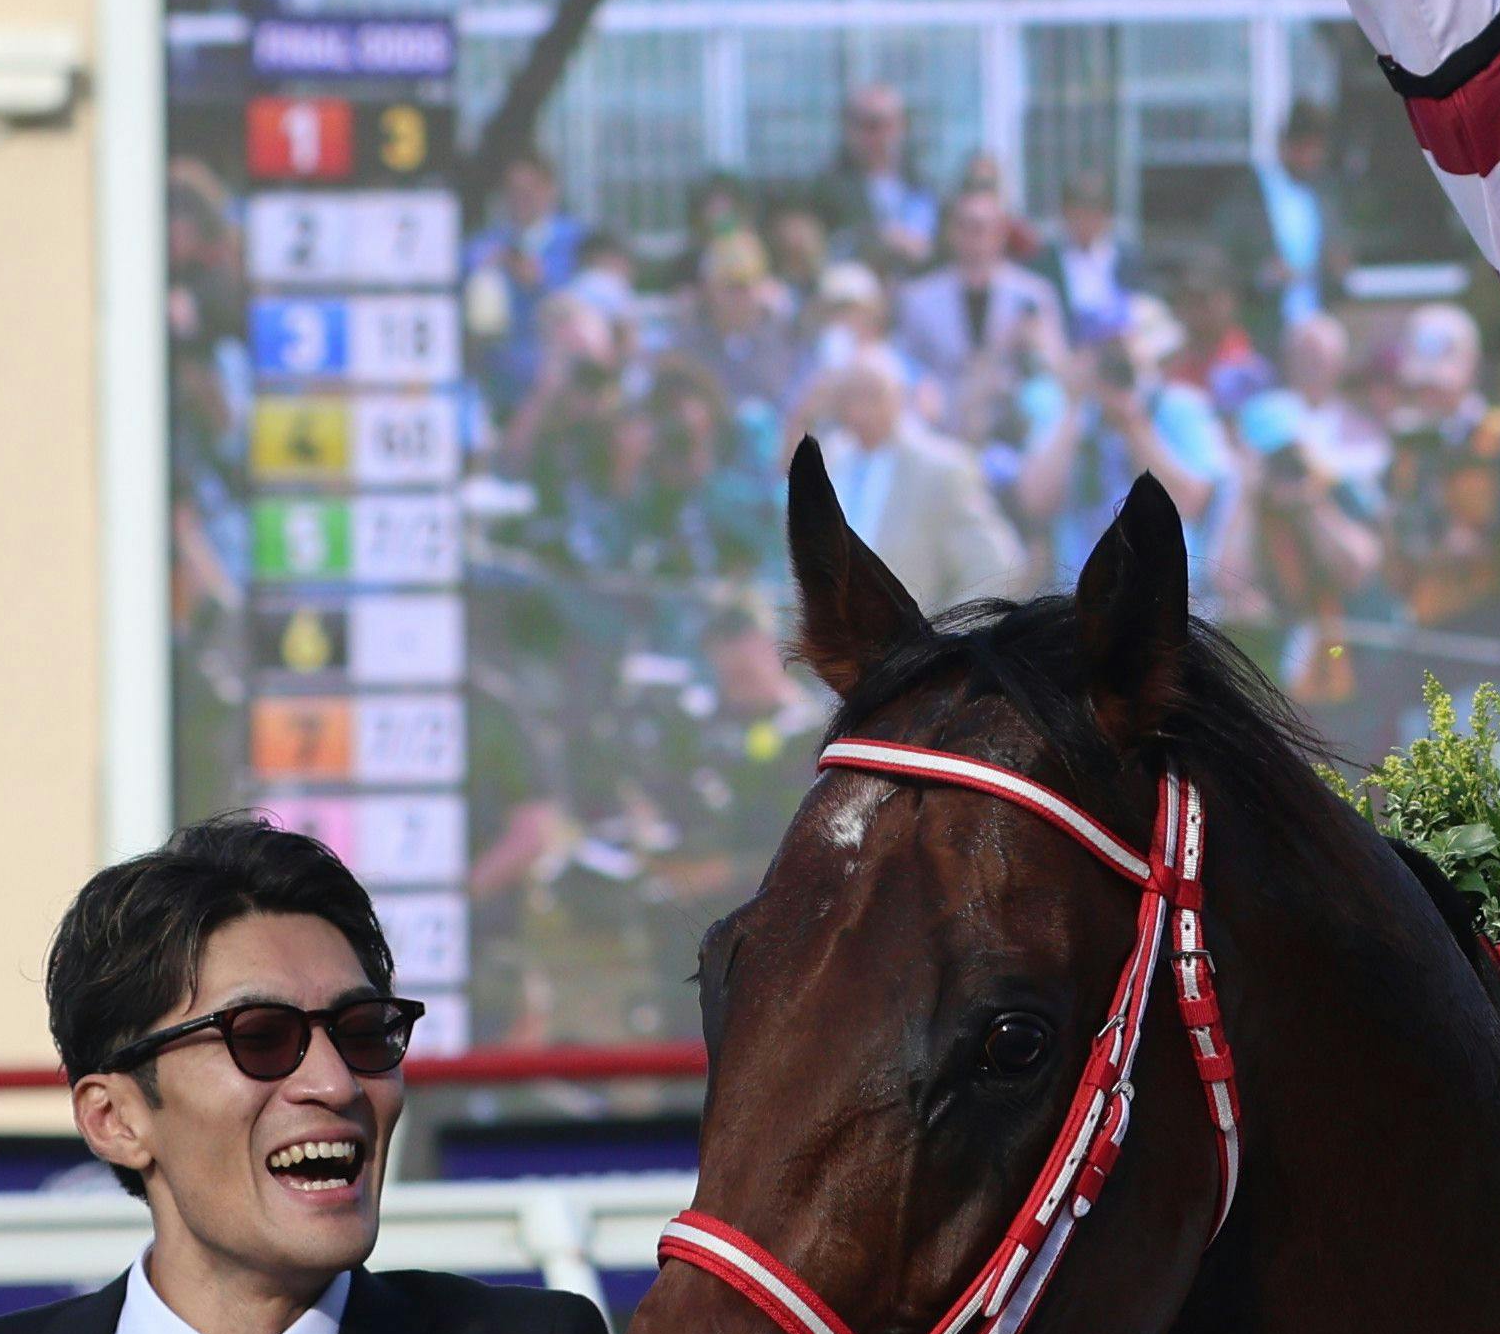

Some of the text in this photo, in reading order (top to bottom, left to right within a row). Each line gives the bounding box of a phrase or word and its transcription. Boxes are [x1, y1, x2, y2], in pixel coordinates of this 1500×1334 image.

[280, 101, 428, 174] 1 3
[280, 301, 327, 370] 3
